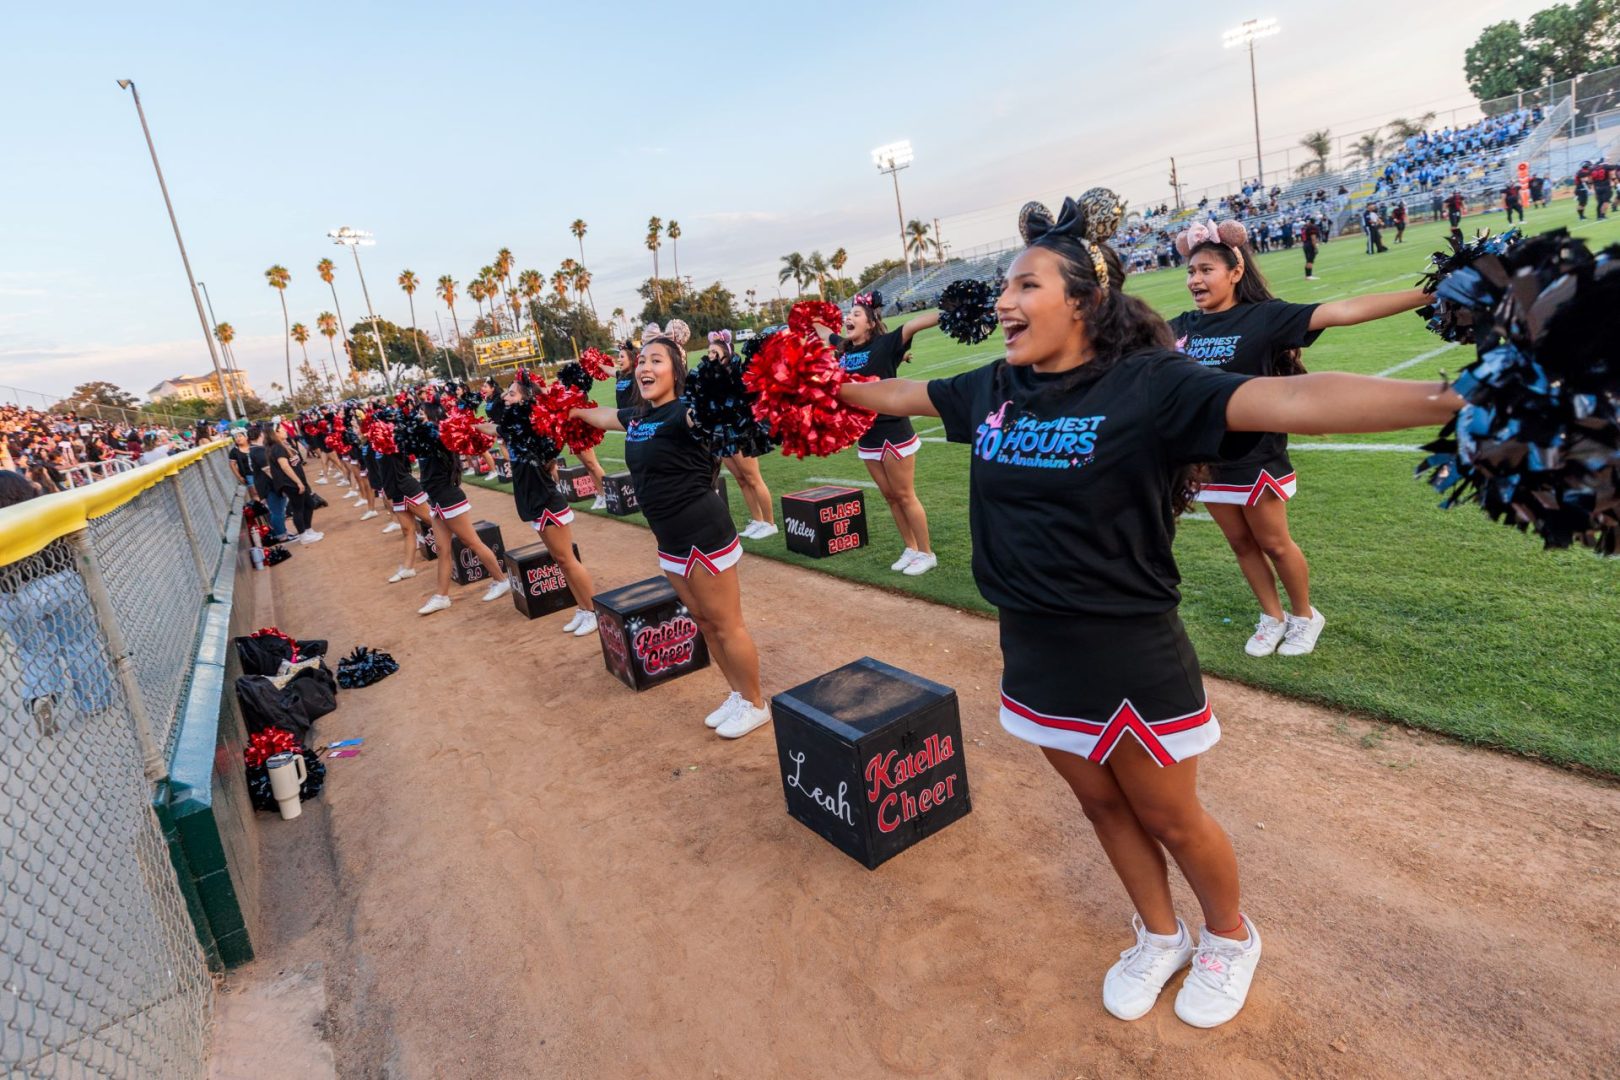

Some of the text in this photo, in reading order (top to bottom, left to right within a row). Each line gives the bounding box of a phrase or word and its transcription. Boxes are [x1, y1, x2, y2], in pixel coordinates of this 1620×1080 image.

[473, 329, 531, 345] GLOVER STADIUM
[1191, 335, 1241, 348] HAPPIEST
[1187, 345, 1236, 358] HOURS
[1014, 415, 1106, 432] HAPPIEST
[1002, 431, 1098, 454] HOURS
[997, 450, 1071, 469] in Anaheim
[820, 500, 861, 523] CLASS
[785, 517, 816, 543] Miley
[833, 518, 850, 536] OF
[828, 532, 860, 554] 2028
[530, 575, 567, 596] CHEE
[634, 616, 697, 657] Katella
[644, 640, 693, 674] Cheer
[865, 733, 955, 802] Katella
[787, 749, 855, 826] Leah
[877, 774, 957, 833] Cheer
